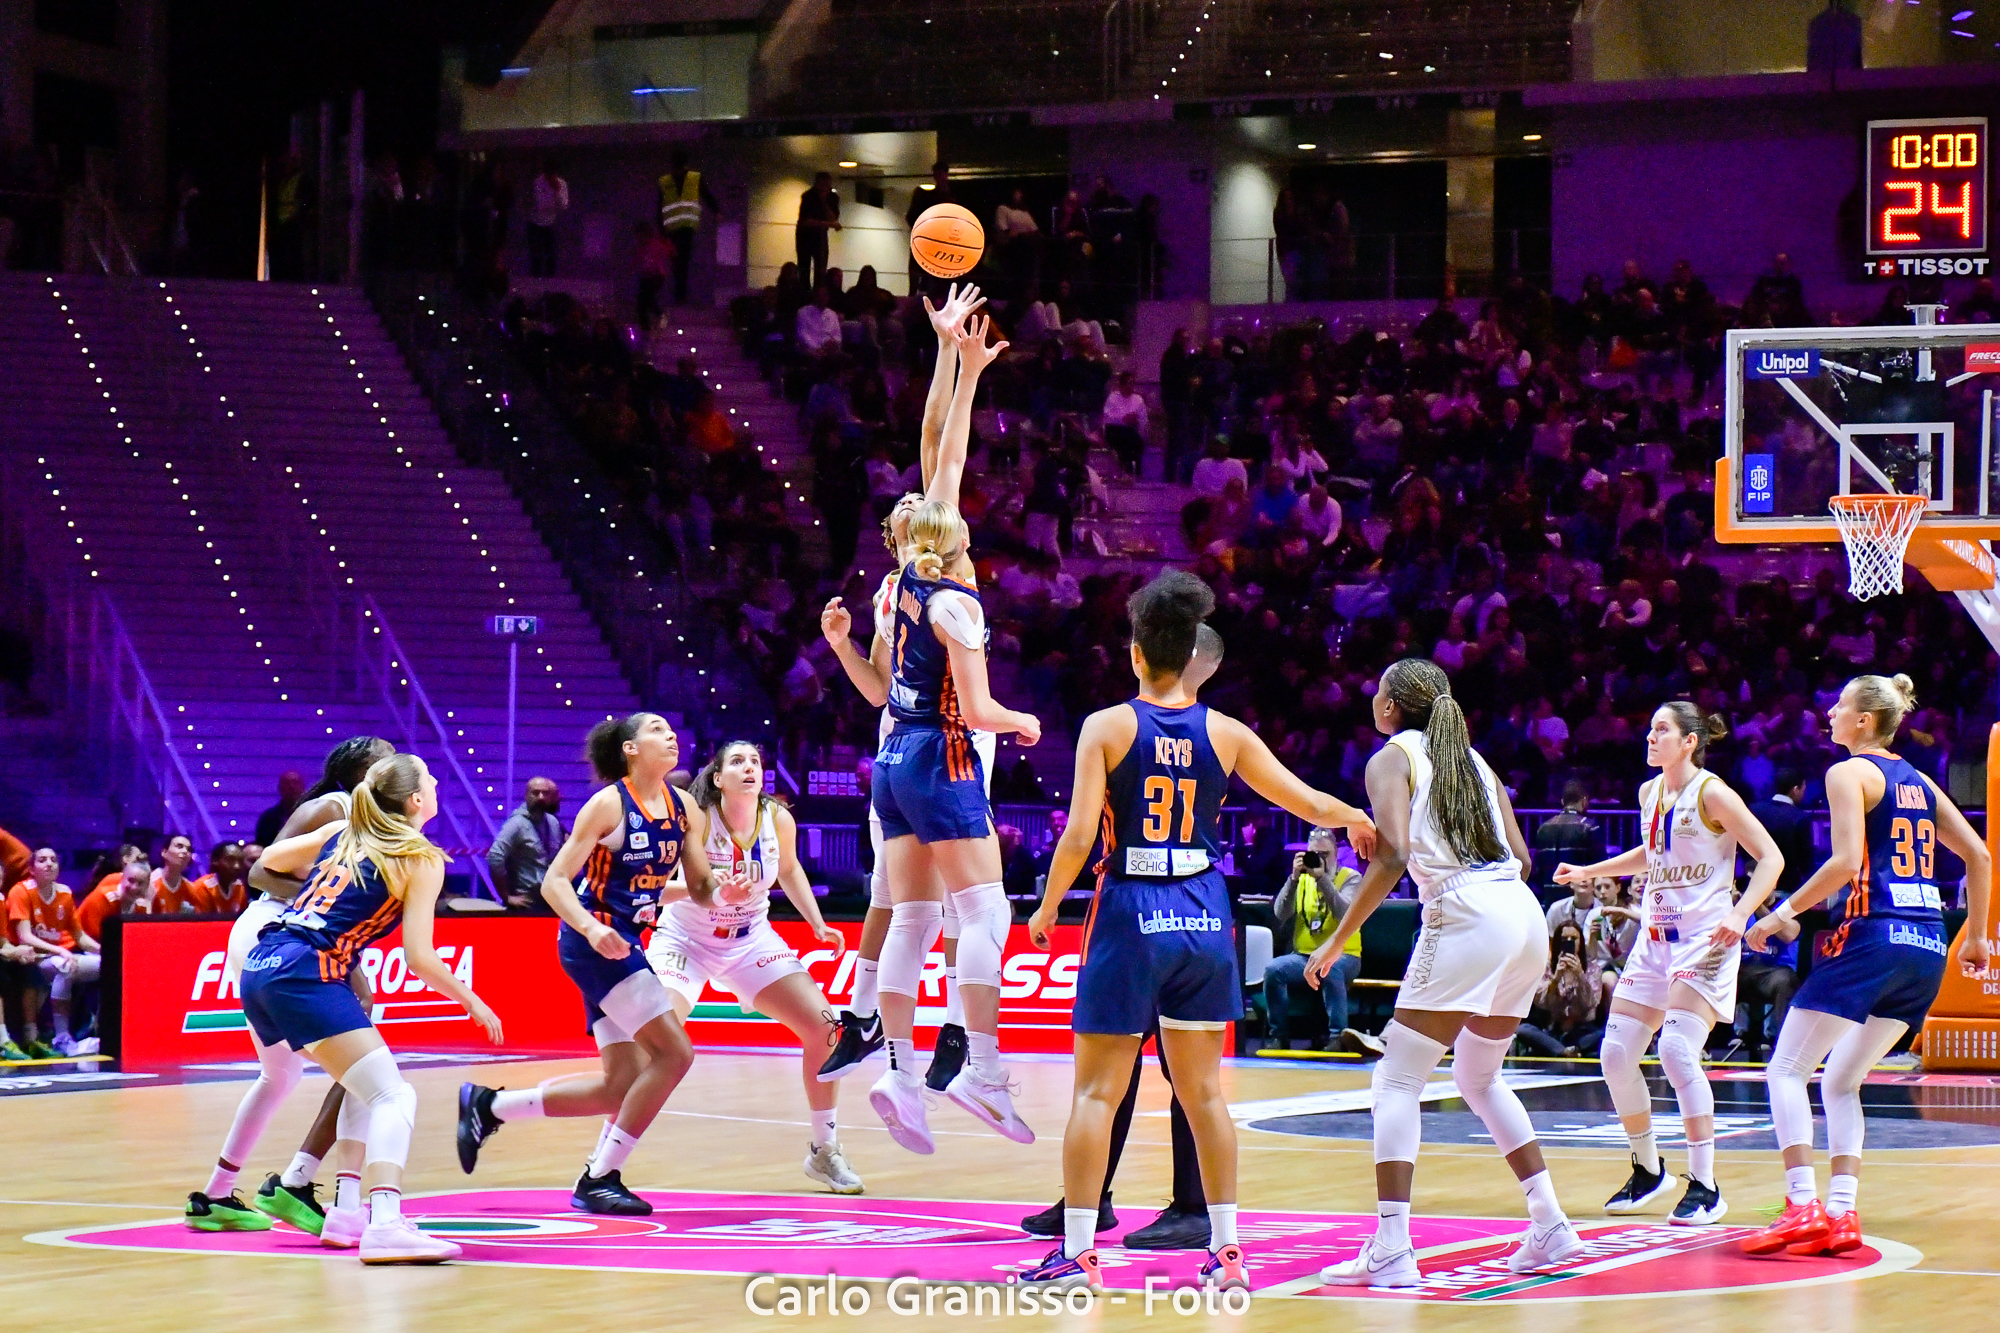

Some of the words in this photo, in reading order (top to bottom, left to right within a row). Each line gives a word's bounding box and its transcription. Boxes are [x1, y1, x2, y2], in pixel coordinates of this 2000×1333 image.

[1892, 133, 1977, 169] 10:00
[1884, 181, 1970, 242] 24
[1898, 258, 1989, 275] TISSOT
[1762, 351, 1809, 375] Unipol
[1748, 492, 1771, 501] FIP
[1154, 736, 1193, 768] KEYS
[1895, 783, 1928, 810] LAKSA
[1143, 775, 1197, 843] 31
[658, 840, 678, 864] 13
[1131, 851, 1161, 860] PISCINE
[1890, 818, 1935, 879] 33
[1131, 860, 1168, 872] SCHIO
[1895, 893, 1923, 903] SCHIO
[665, 953, 687, 972] 20
